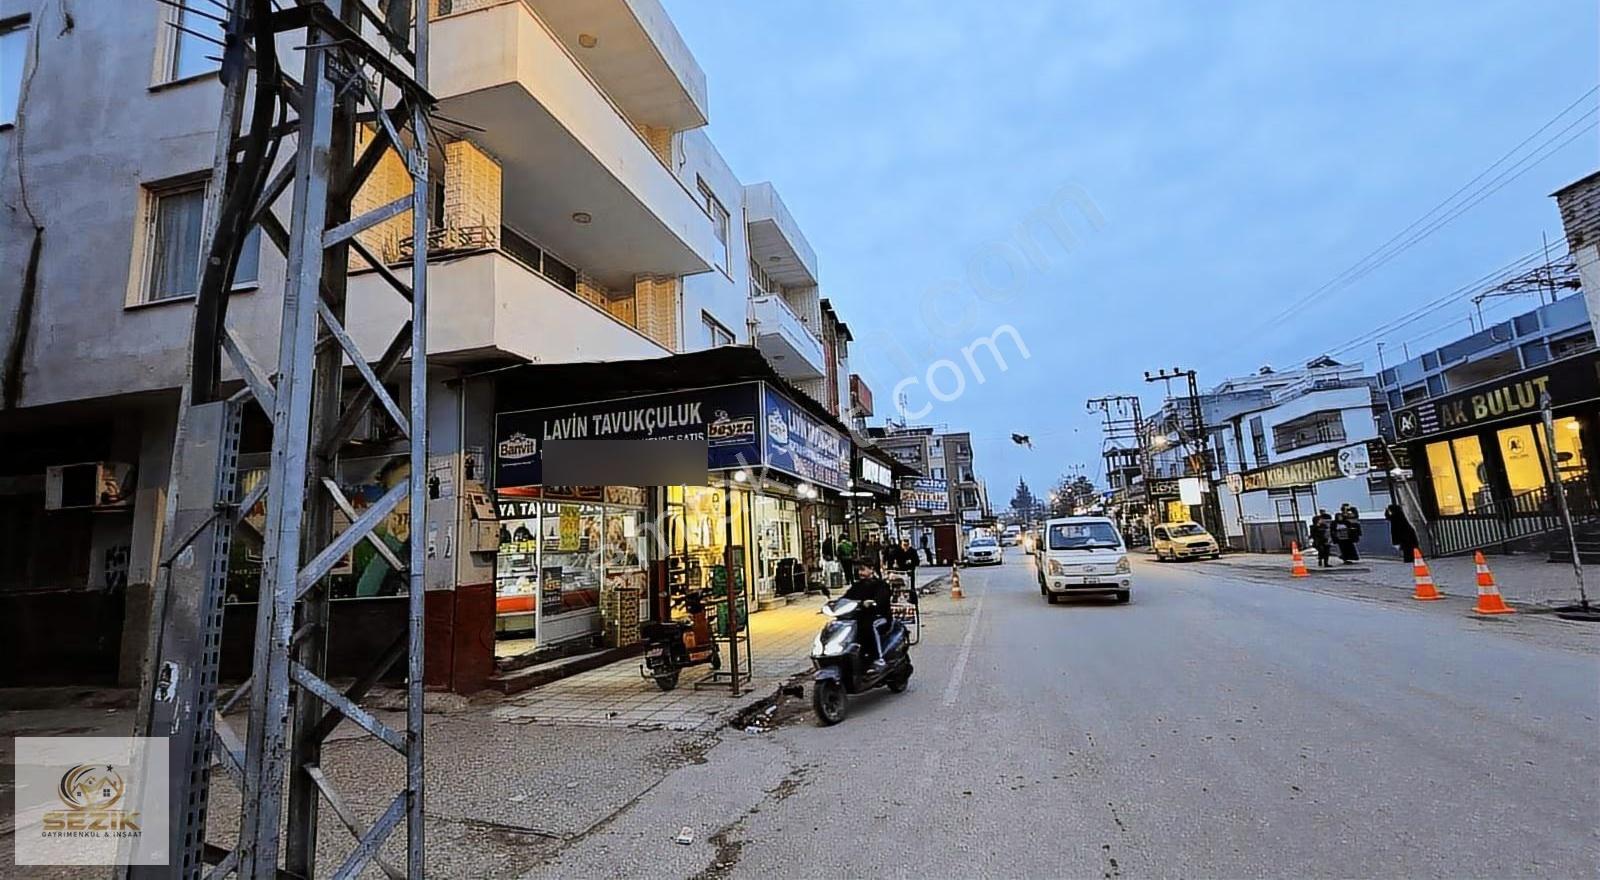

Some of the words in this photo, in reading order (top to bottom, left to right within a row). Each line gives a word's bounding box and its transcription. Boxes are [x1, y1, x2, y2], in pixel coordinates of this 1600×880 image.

[1442, 400, 1469, 427] AK
[1472, 375, 1549, 420] BULUT
[543, 412, 588, 440] LAVİN
[592, 402, 703, 435] TAVUKÇULUK
[500, 440, 534, 456] Banvit
[1266, 457, 1338, 488] KIRAATHANE
